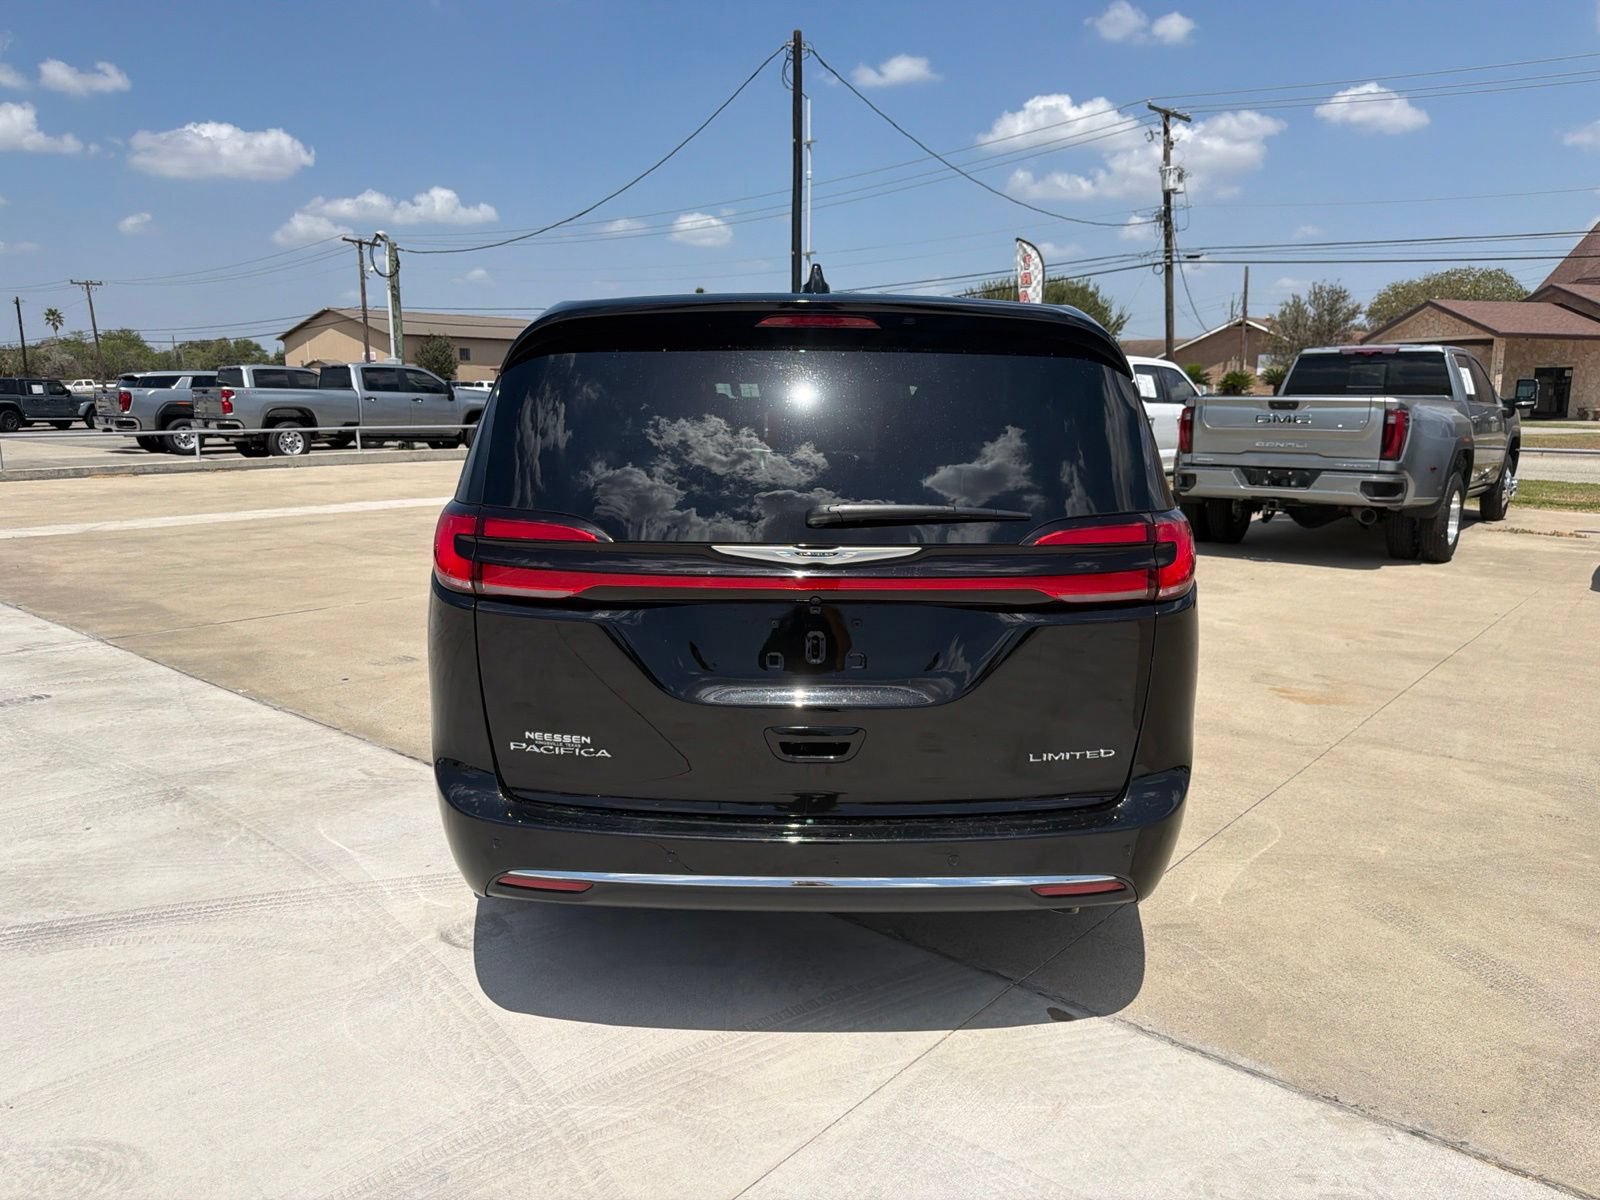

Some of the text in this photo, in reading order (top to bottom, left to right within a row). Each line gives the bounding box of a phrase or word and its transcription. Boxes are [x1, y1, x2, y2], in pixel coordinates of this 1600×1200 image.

[1256, 414, 1312, 425] GMC
[525, 731, 591, 744] NEESSEN
[510, 741, 612, 758] PACIFICA
[1029, 748, 1115, 762] LIMITED
